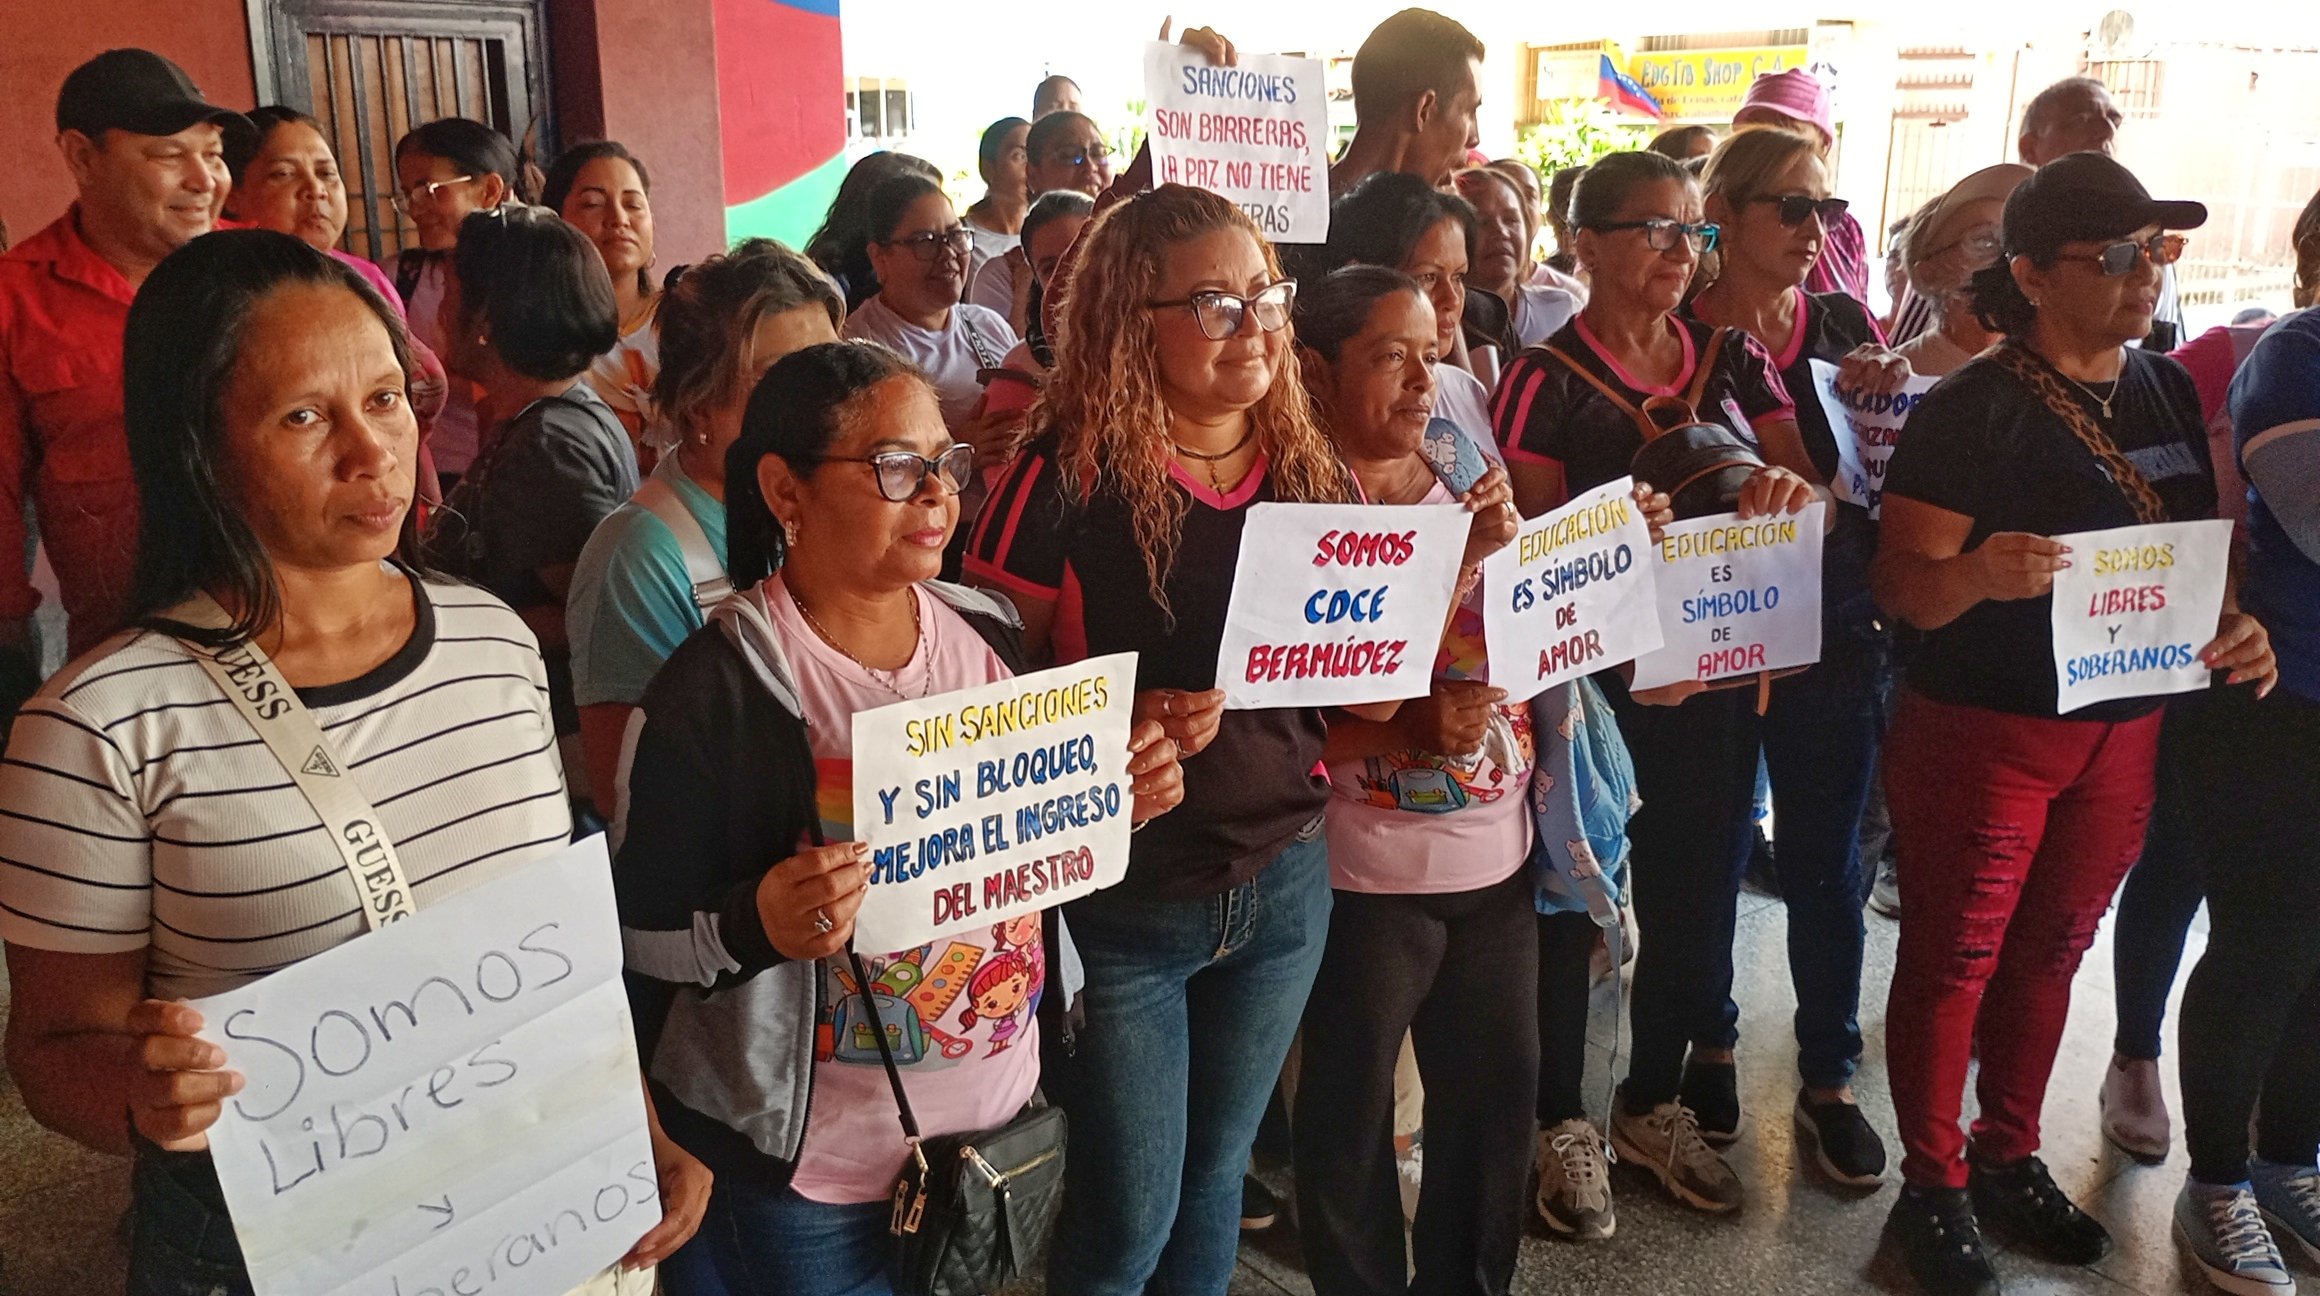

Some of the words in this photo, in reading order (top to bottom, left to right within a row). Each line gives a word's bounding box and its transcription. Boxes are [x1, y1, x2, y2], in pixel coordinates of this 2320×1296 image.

[1182, 65, 1296, 104] SANCIONES
[1704, 57, 1743, 86] SHOP
[1156, 108, 1193, 140] SON
[1199, 112, 1310, 156] BARRERAS,
[1161, 154, 1178, 183] LA
[1185, 157, 1219, 189] PAZ
[1226, 160, 1253, 190] NO
[1259, 162, 1312, 192] TIENE
[1312, 529, 1417, 568] SOMOS
[1519, 493, 1629, 567] EDUCACIÓN
[1661, 512, 1797, 563] EDUCACIÓN
[1512, 577, 1534, 613] ES
[1541, 543, 1632, 601] SÍMBOLO
[1711, 564, 1732, 583] ES
[2094, 542, 2175, 577] SOMOS
[1304, 585, 1389, 624] CDCE
[1555, 602, 1577, 630] DE
[1682, 585, 1779, 624] SÍMBOLO
[2089, 585, 2166, 618] LIBRES
[1537, 628, 1604, 681] AMOR
[1711, 626, 1731, 643] DE
[2108, 624, 2122, 644] Y
[1245, 635, 1408, 684] BERMÚDEZ
[1697, 642, 1766, 679] AMOR
[2066, 643, 2193, 687] SOBERANOS
[906, 713, 954, 757] SIN
[960, 675, 1108, 743] SANCIONES
[878, 786, 901, 825] Y
[915, 769, 961, 819] SIN
[977, 734, 1098, 799] BLOQUEO,
[870, 822, 976, 885] MEJORA
[982, 814, 1010, 856] EL
[1016, 782, 1121, 845] INGRESO
[933, 879, 977, 926] DEL
[983, 845, 1094, 910] MAESTRO
[224, 922, 573, 1122] Somos
[260, 1039, 517, 1195] Libres
